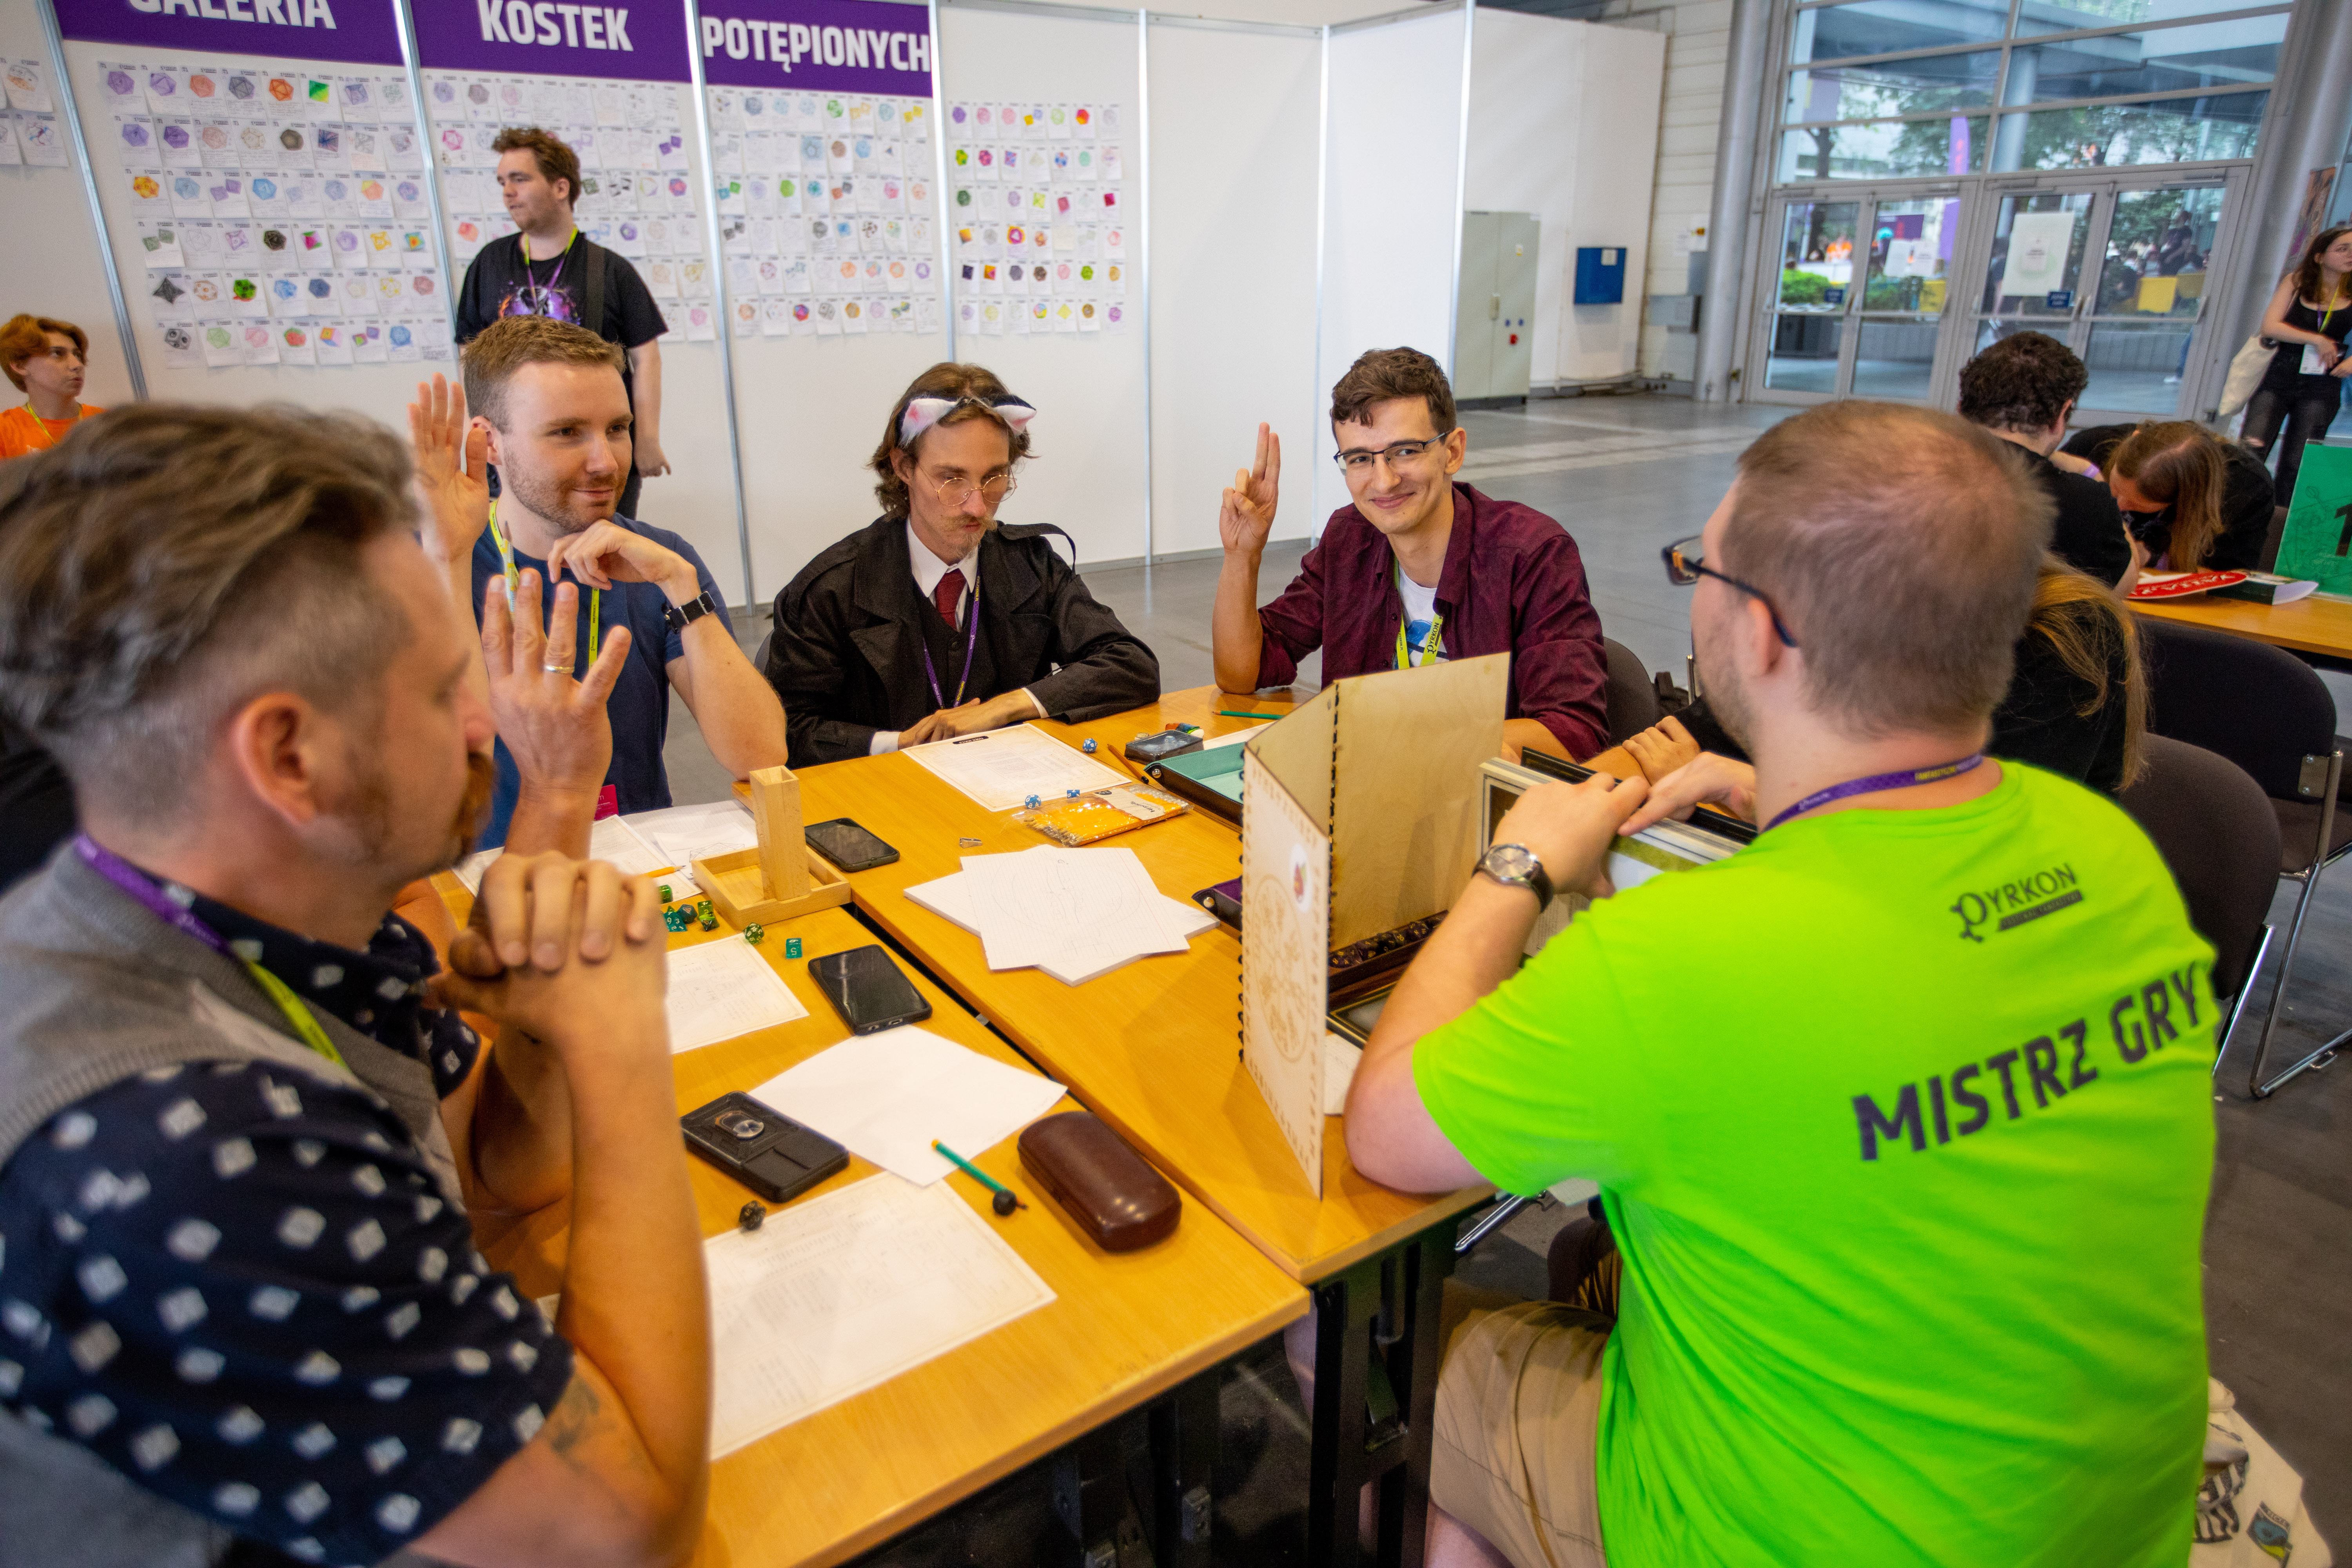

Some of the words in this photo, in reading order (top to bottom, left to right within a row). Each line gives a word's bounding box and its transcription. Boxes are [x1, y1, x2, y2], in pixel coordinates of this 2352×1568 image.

[478, 0, 633, 52] KOSTEK
[701, 16, 931, 73] POTĘPIONYCH
[1427, 622, 1439, 654] PYRKON
[1950, 862, 2077, 942] PYRKON
[1852, 1018, 2098, 1161] MISTRZ
[2109, 961, 2198, 1064] GRY
